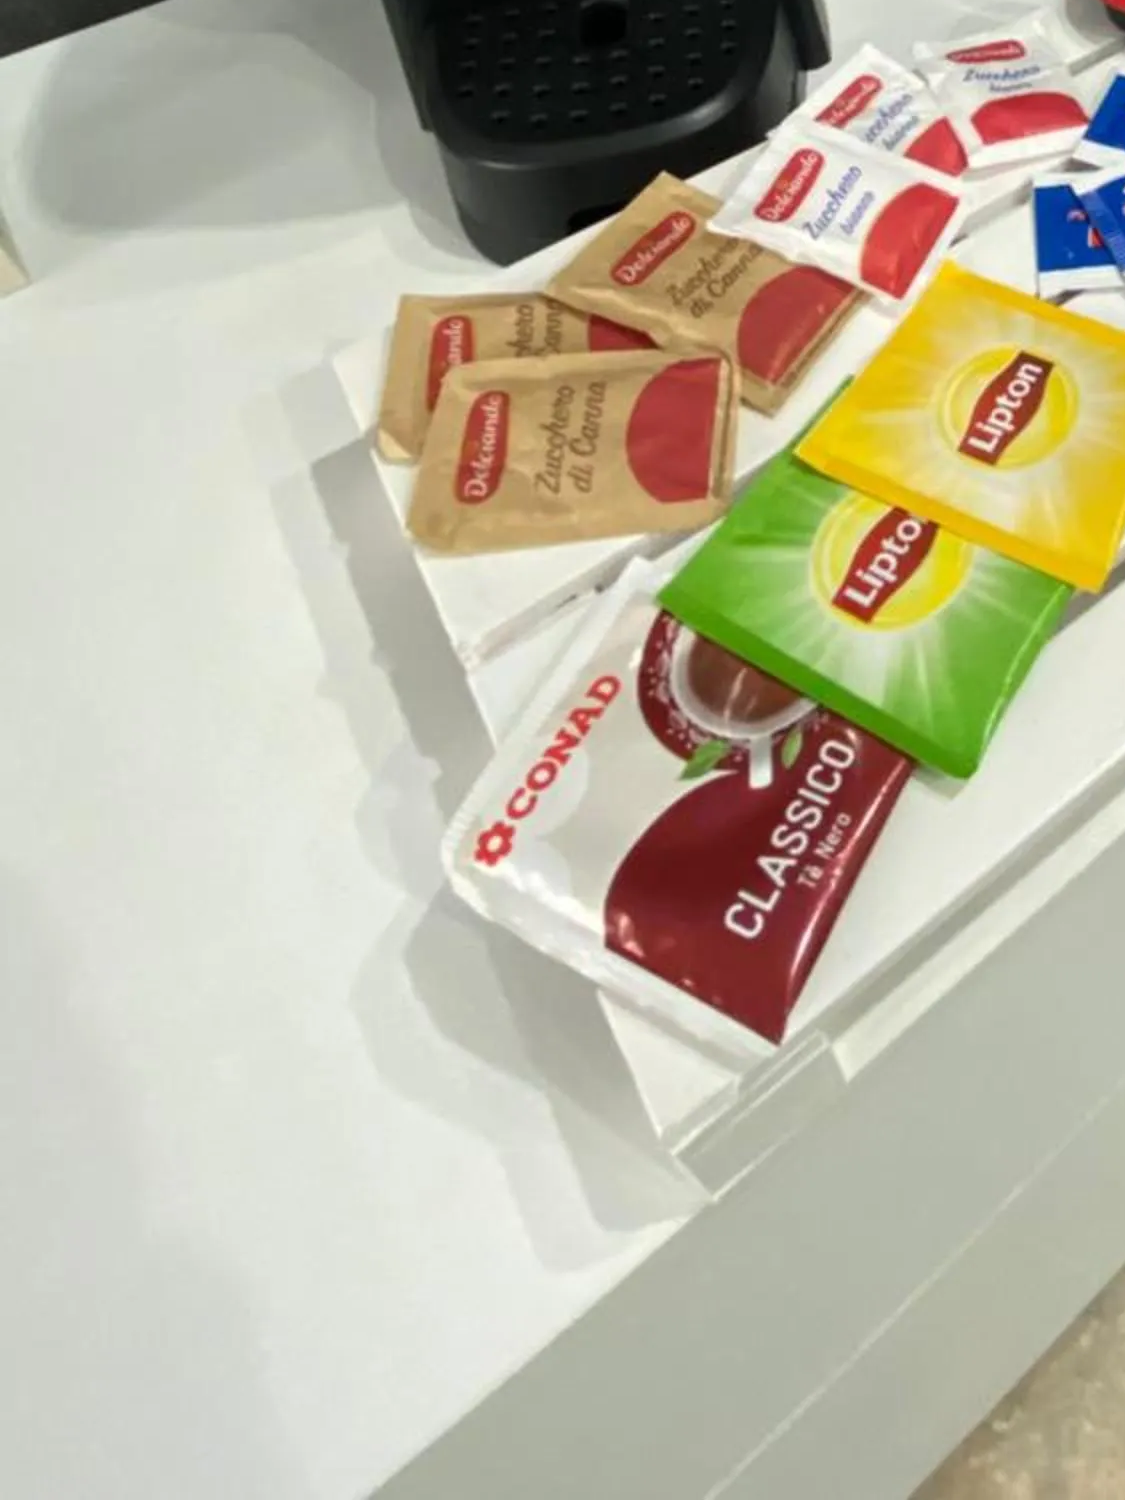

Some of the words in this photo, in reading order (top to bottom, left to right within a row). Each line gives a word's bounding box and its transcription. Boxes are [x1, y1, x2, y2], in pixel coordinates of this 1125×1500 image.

[760, 153, 820, 220] Dolciando
[802, 165, 862, 241] Zucchero
[614, 217, 692, 283] Dolciando
[690, 298, 716, 319] di
[464, 394, 504, 497] Dolciando
[534, 385, 576, 495] Zucchero
[568, 382, 607, 457] Canna
[967, 361, 1045, 454] Lipton
[568, 465, 594, 494] di
[844, 518, 924, 608] Lipto
[505, 674, 622, 821] CONAD
[723, 740, 856, 940] CLASSICO
[812, 812, 852, 860] Nero
